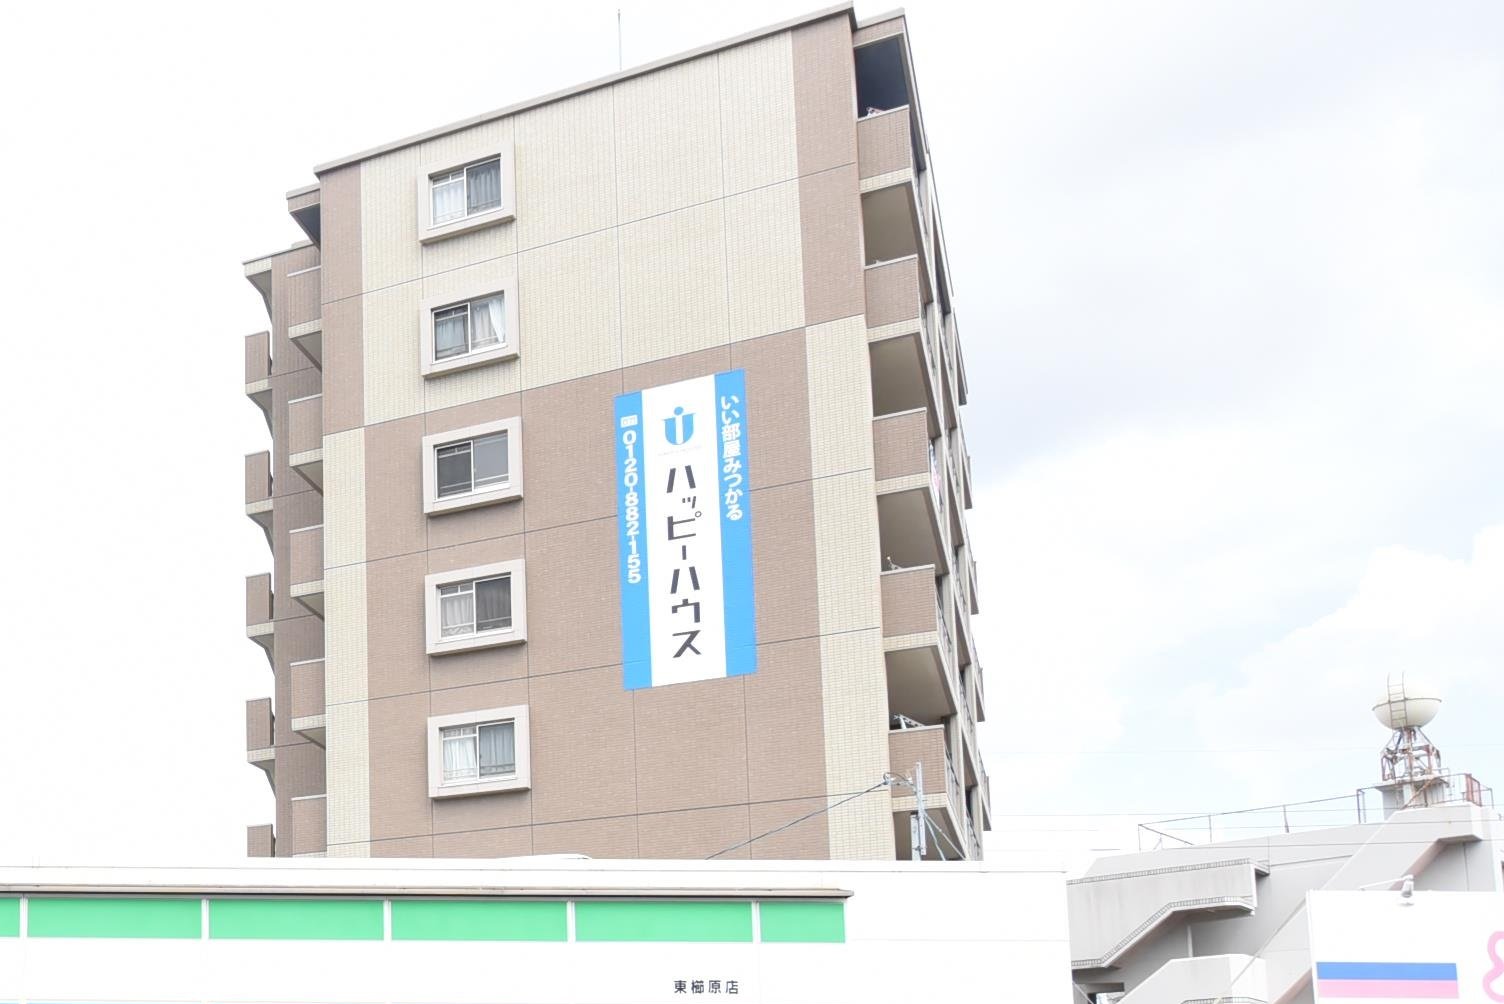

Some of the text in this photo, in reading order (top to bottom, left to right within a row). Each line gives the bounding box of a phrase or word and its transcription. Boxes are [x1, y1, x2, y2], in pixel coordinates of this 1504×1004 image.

[720, 394, 744, 521] いい部屋みつかる
[666, 464, 702, 658] ハッピーハウス
[673, 979, 739, 995] 東櫛原店
